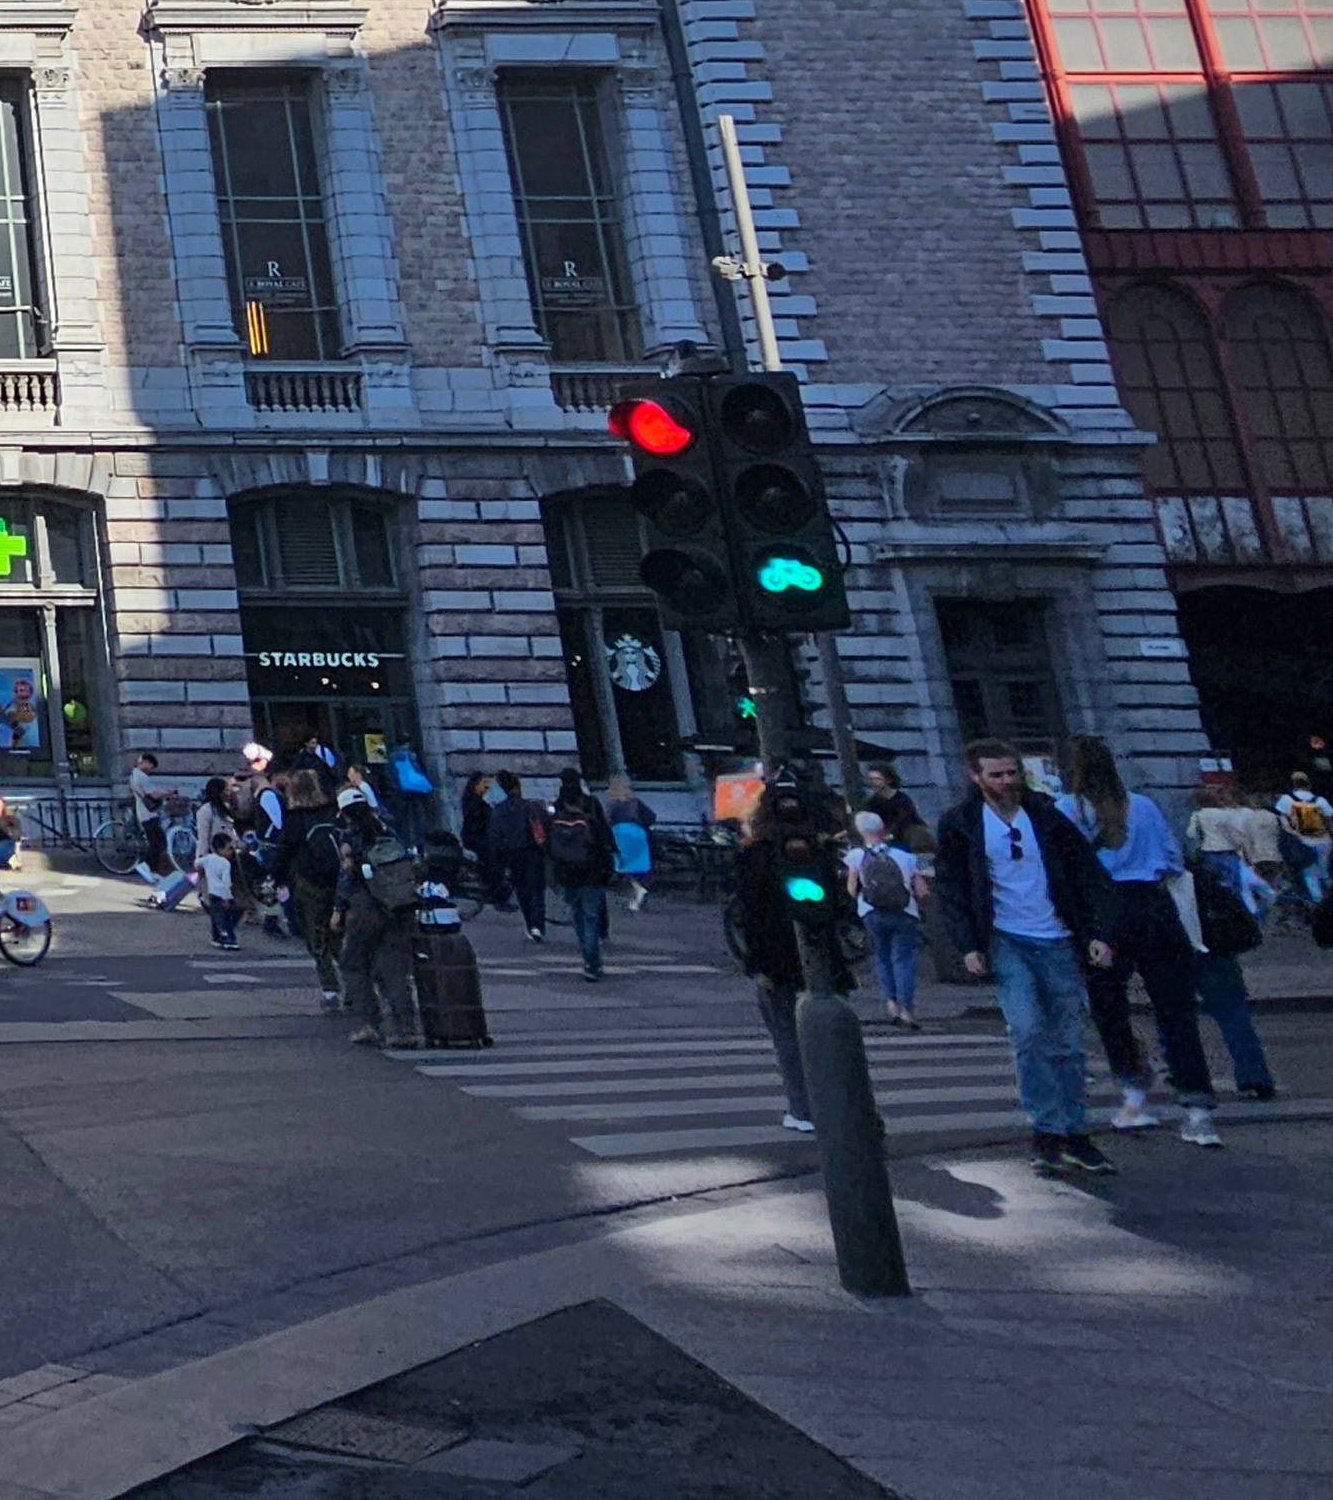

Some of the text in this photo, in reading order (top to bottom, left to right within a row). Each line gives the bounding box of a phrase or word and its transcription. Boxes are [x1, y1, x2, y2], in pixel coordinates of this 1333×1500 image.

[267, 261, 281, 277] R
[564, 261, 577, 277] R
[259, 652, 379, 668] STARBUCKS
